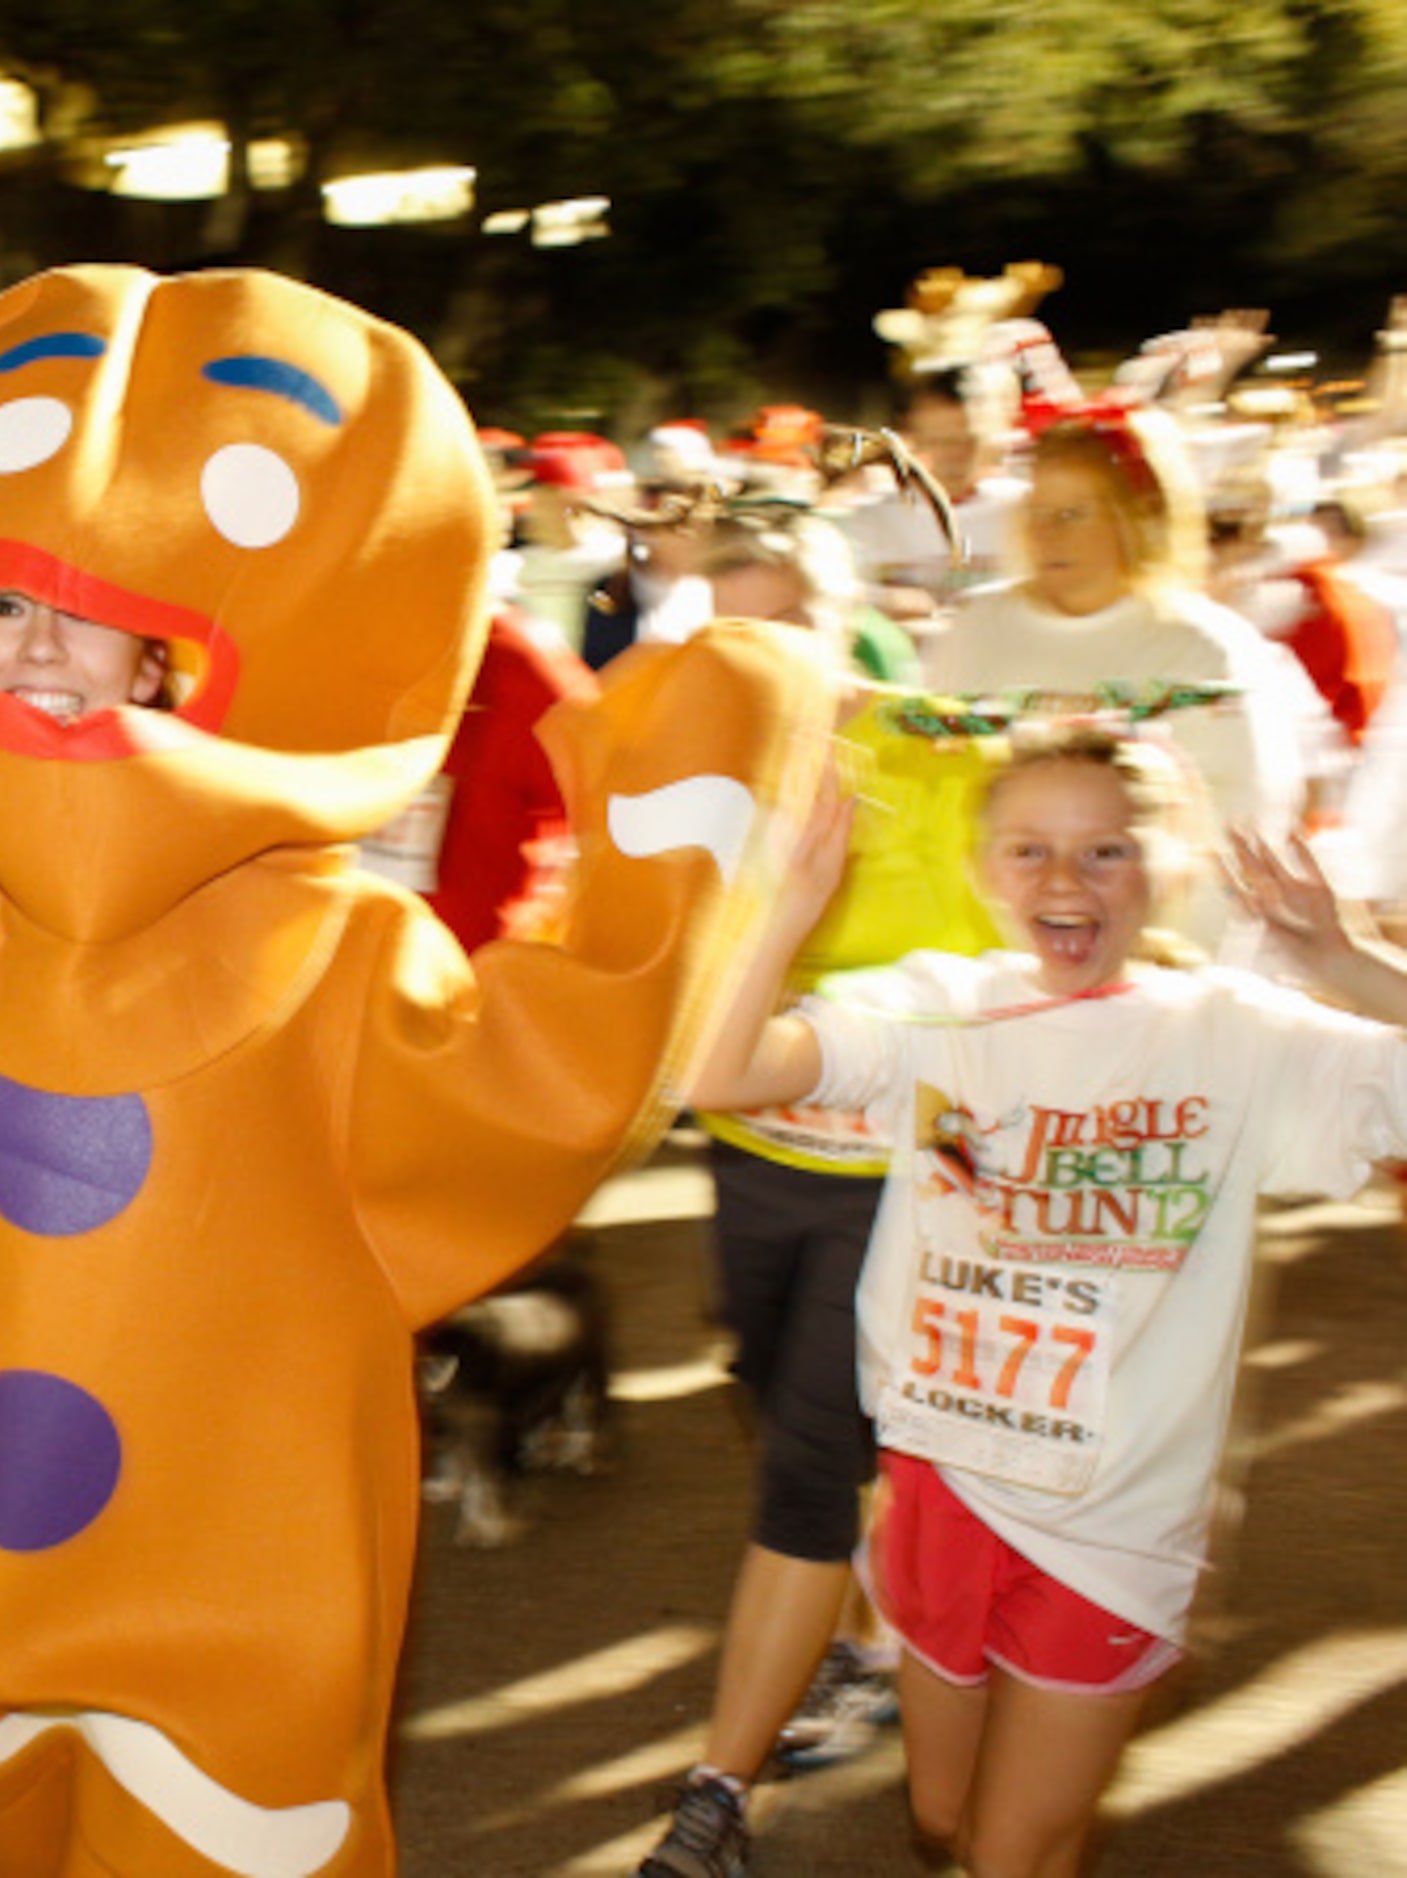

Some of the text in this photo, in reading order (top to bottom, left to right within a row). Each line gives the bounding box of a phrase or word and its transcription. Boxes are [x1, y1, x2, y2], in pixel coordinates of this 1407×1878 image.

[1041, 1142, 1209, 1187] BELL
[918, 1250, 1100, 1316] LUKE'S
[910, 1296, 1096, 1411] 5177
[900, 1381, 1085, 1442] LOCKER
